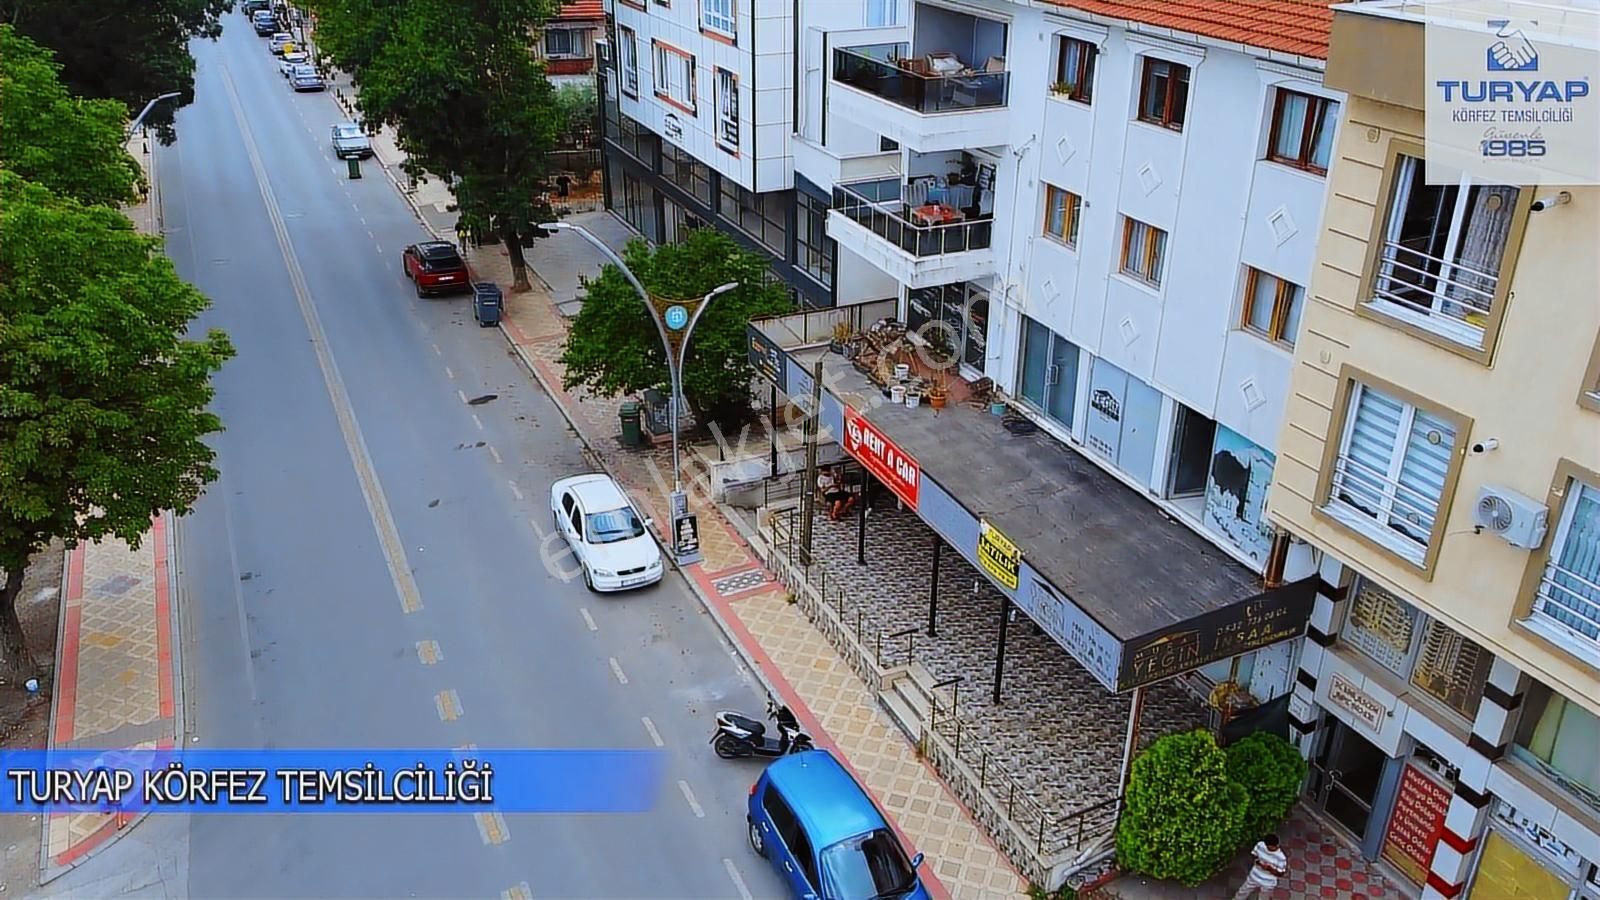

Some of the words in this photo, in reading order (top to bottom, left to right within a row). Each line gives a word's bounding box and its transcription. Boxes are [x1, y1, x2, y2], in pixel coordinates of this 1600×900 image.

[863, 427, 886, 460] RENT
[887, 448, 894, 469] A
[896, 456, 916, 487] CAR
